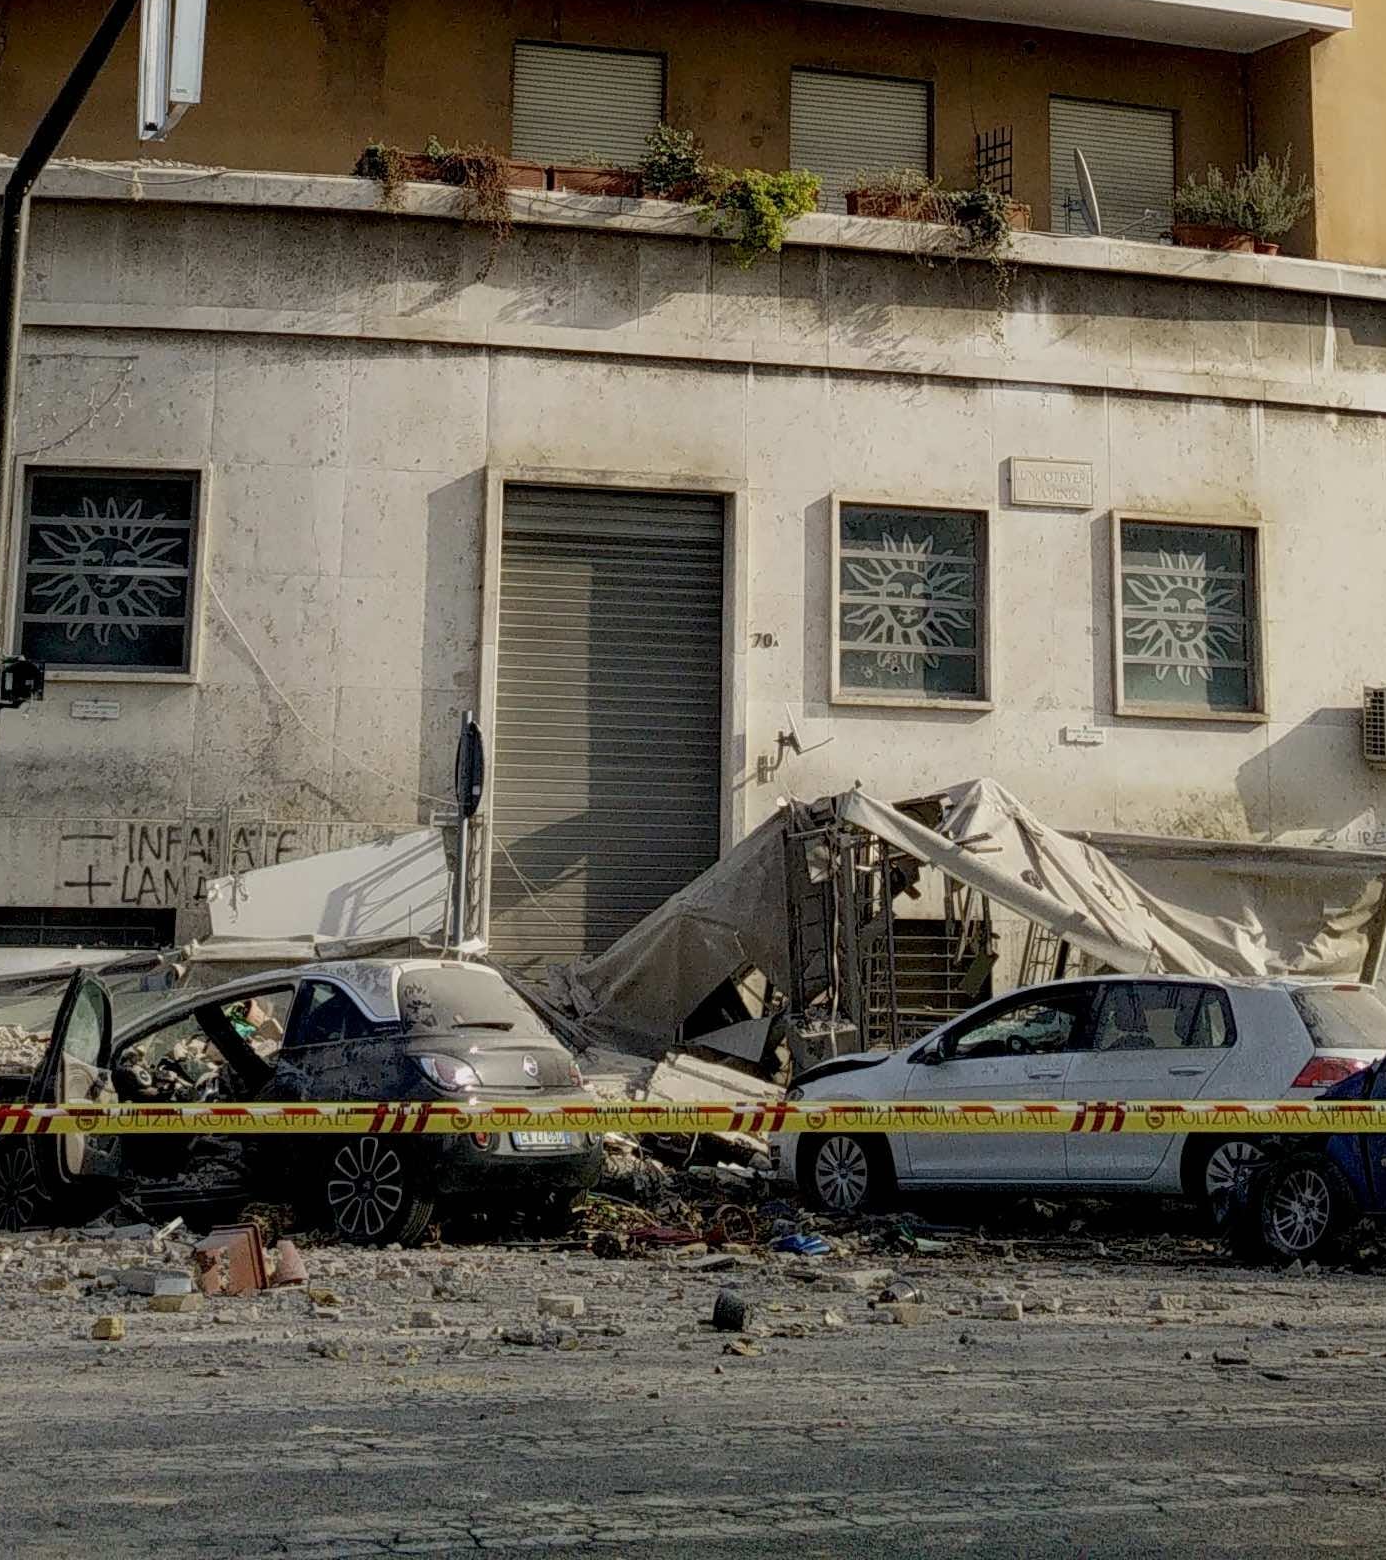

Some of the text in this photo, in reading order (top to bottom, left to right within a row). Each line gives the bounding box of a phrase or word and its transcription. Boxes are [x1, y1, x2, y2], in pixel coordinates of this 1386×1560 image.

[1028, 487, 1081, 500] FLAMINIO
[193, 1113, 258, 1128] ROMA
[264, 1113, 355, 1128] CAPITALE
[480, 1111, 714, 1127] POLIZIA ROMA CAPITALE
[834, 1111, 1058, 1127] POLIZIA ROMA CAPITALE
[1170, 1110, 1386, 1126] POLIZIA ROMA CAPITALE
